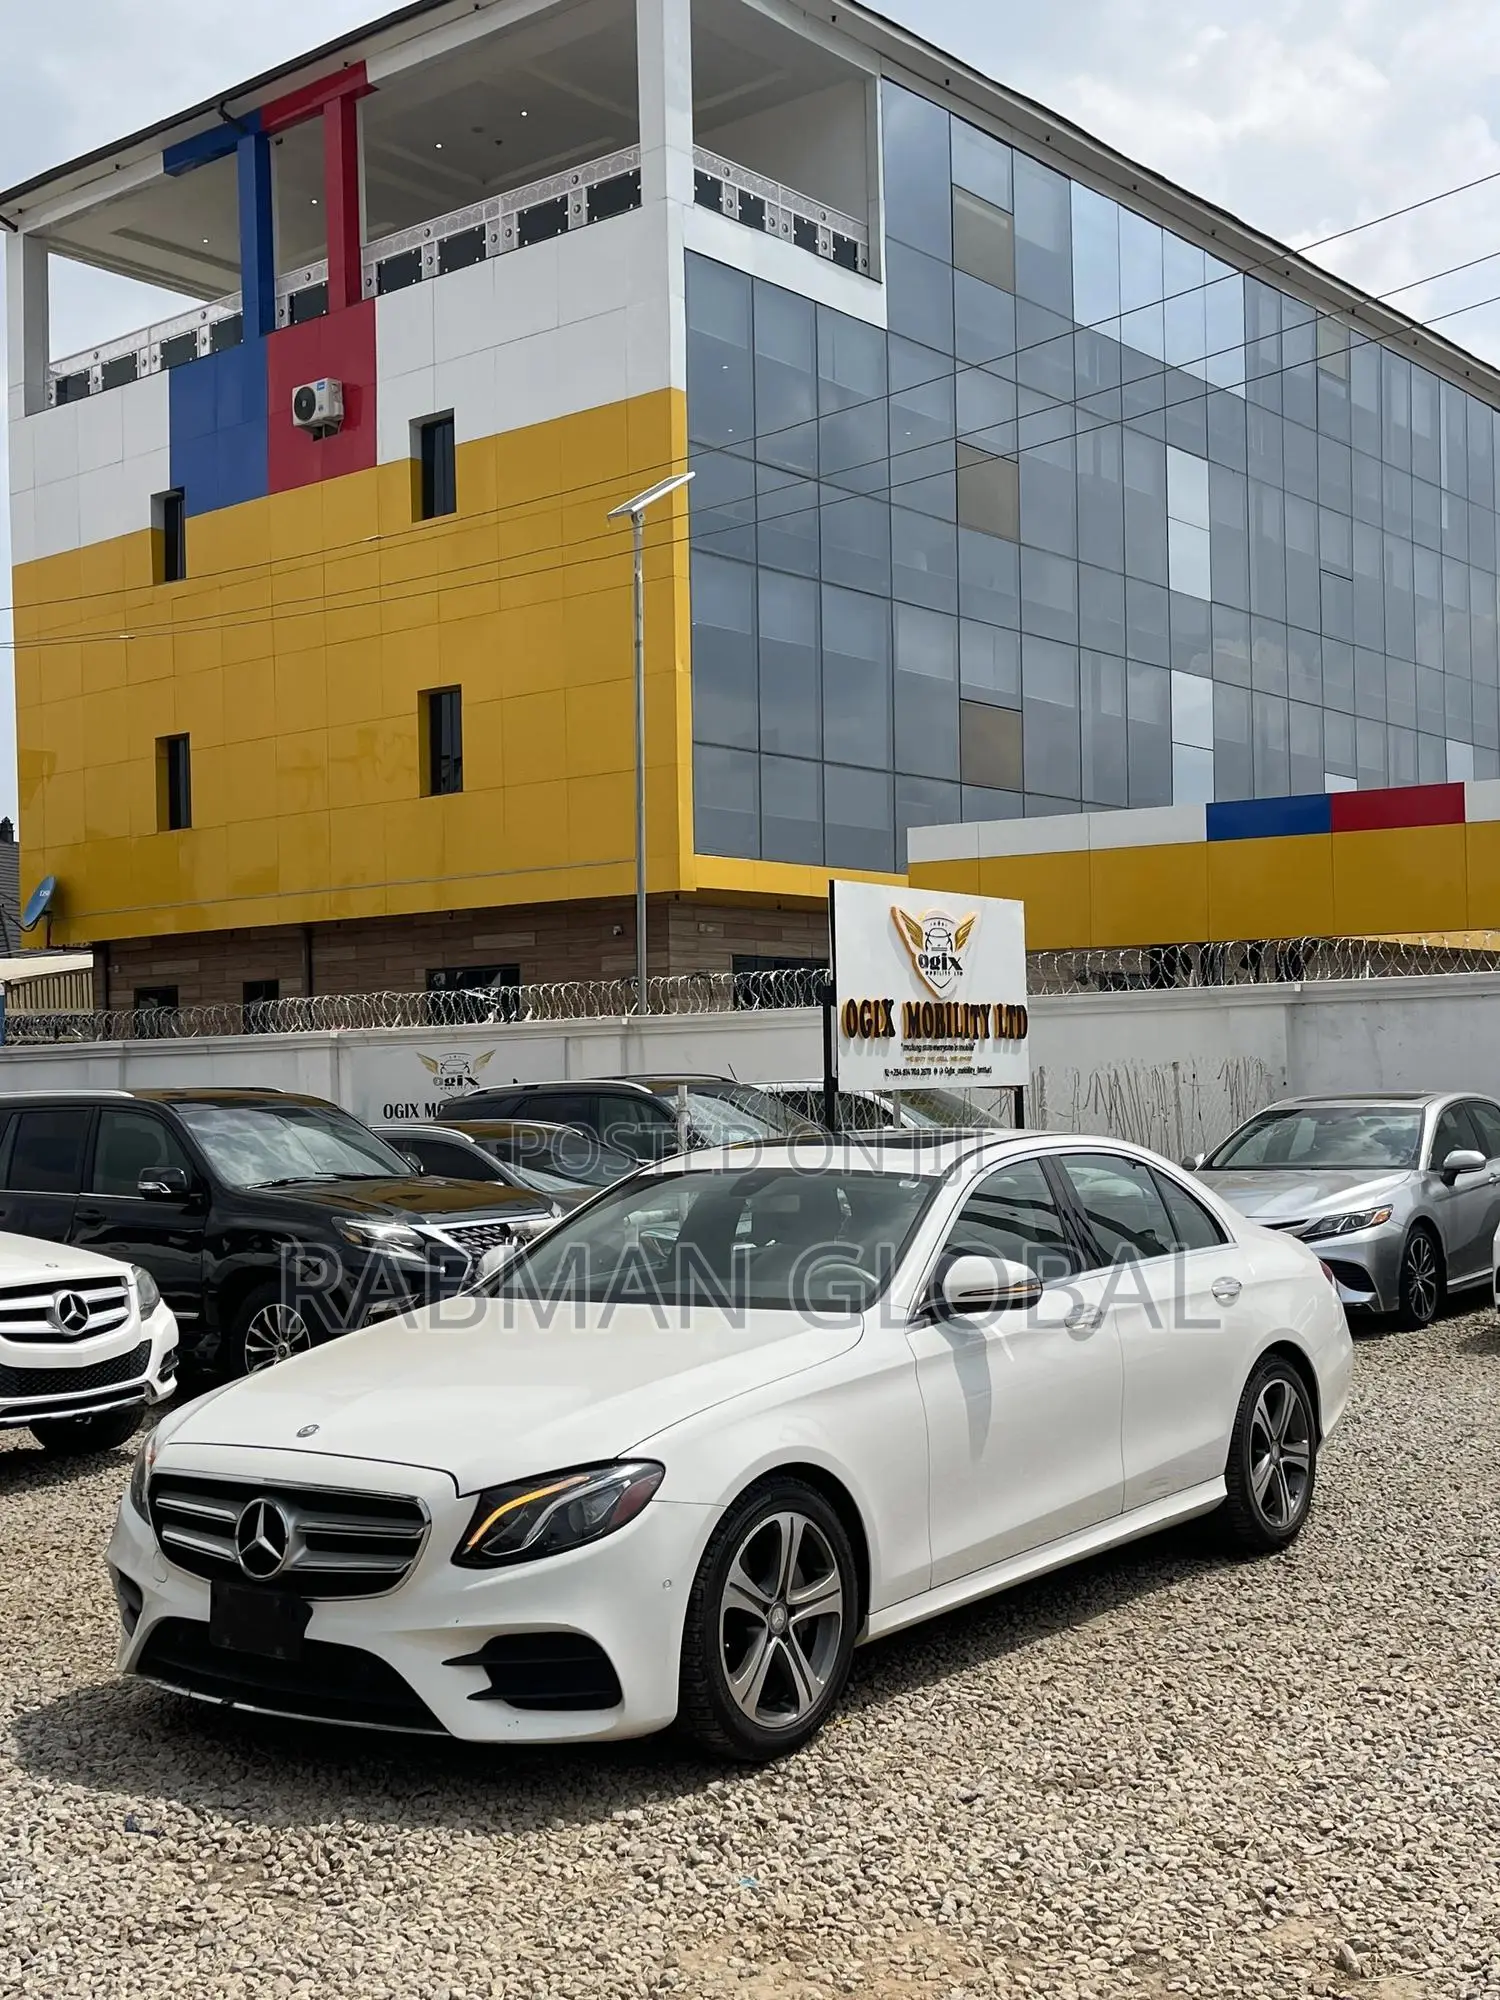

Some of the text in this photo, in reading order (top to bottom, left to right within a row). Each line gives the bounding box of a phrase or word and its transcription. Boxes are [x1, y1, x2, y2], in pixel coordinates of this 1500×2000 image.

[841, 998, 1029, 1040] OGIX MOBILITY LTD
[383, 1103, 420, 1119] OGIX
